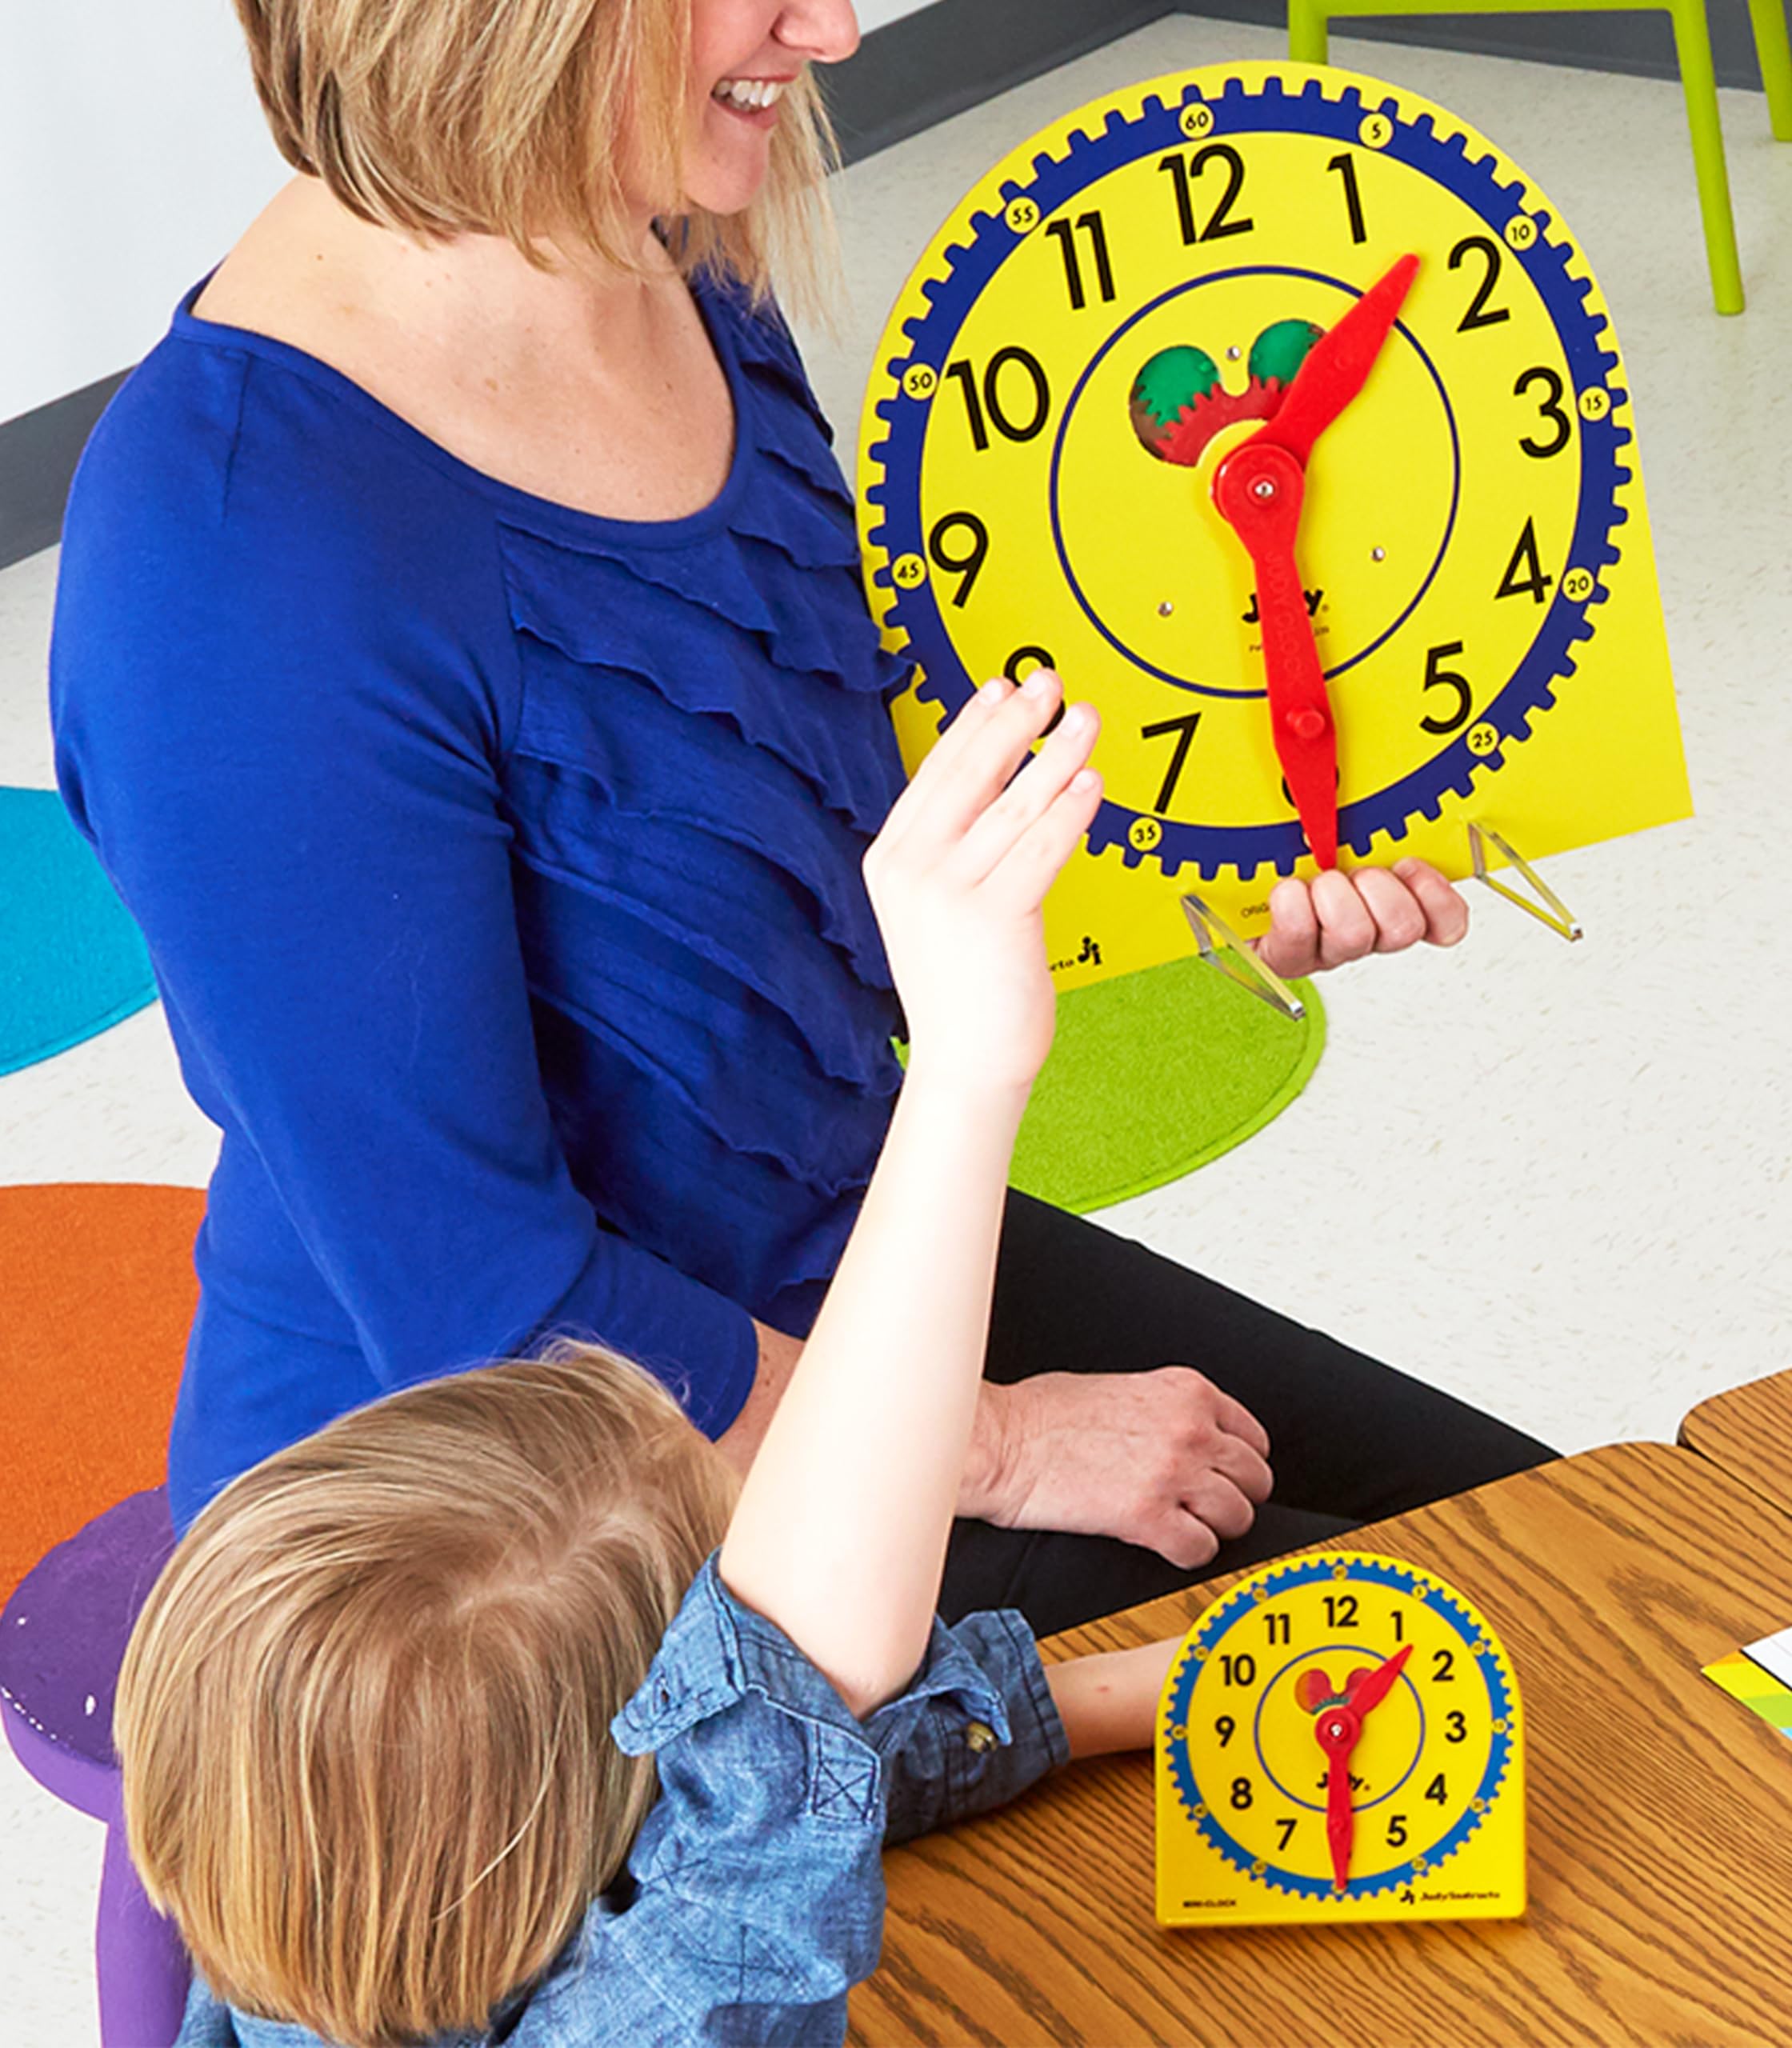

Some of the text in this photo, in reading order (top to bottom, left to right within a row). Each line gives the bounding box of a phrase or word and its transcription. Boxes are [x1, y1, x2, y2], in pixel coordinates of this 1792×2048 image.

[1186, 111, 1209, 130] 60
[1372, 122, 1382, 139] 5
[1158, 143, 1254, 246] 12
[1326, 153, 1367, 245] 1
[1013, 206, 1034, 225] 55
[1512, 224, 1530, 241] 10
[1045, 210, 1116, 310] 11
[1448, 236, 1510, 334] 2
[910, 371, 932, 391] 50
[945, 346, 1050, 452] 10
[1513, 366, 1571, 459] 3
[1586, 396, 1602, 410] 15
[897, 562, 919, 579] 45
[928, 511, 990, 609] 9
[1494, 516, 1553, 604] 4
[1568, 576, 1589, 594] 20
[1242, 589, 1325, 623] Jy
[1419, 640, 1473, 735] 5
[1473, 730, 1493, 749] 25
[1141, 712, 1202, 815] 7
[1135, 825, 1156, 843] 35
[1322, 1595, 1358, 1628] 12
[1390, 1610, 1402, 1642] 1
[1263, 1613, 1290, 1645] 11
[1219, 1654, 1256, 1687] 10
[1431, 1650, 1454, 1682] 2
[1214, 1715, 1236, 1748] 9
[1445, 1710, 1467, 1743] 3
[1230, 1777, 1254, 1810] 8
[1316, 1771, 1365, 1793] Jy
[1425, 1773, 1448, 1806] 4
[1275, 1818, 1298, 1851] 7
[1385, 1814, 1407, 1848] 5
